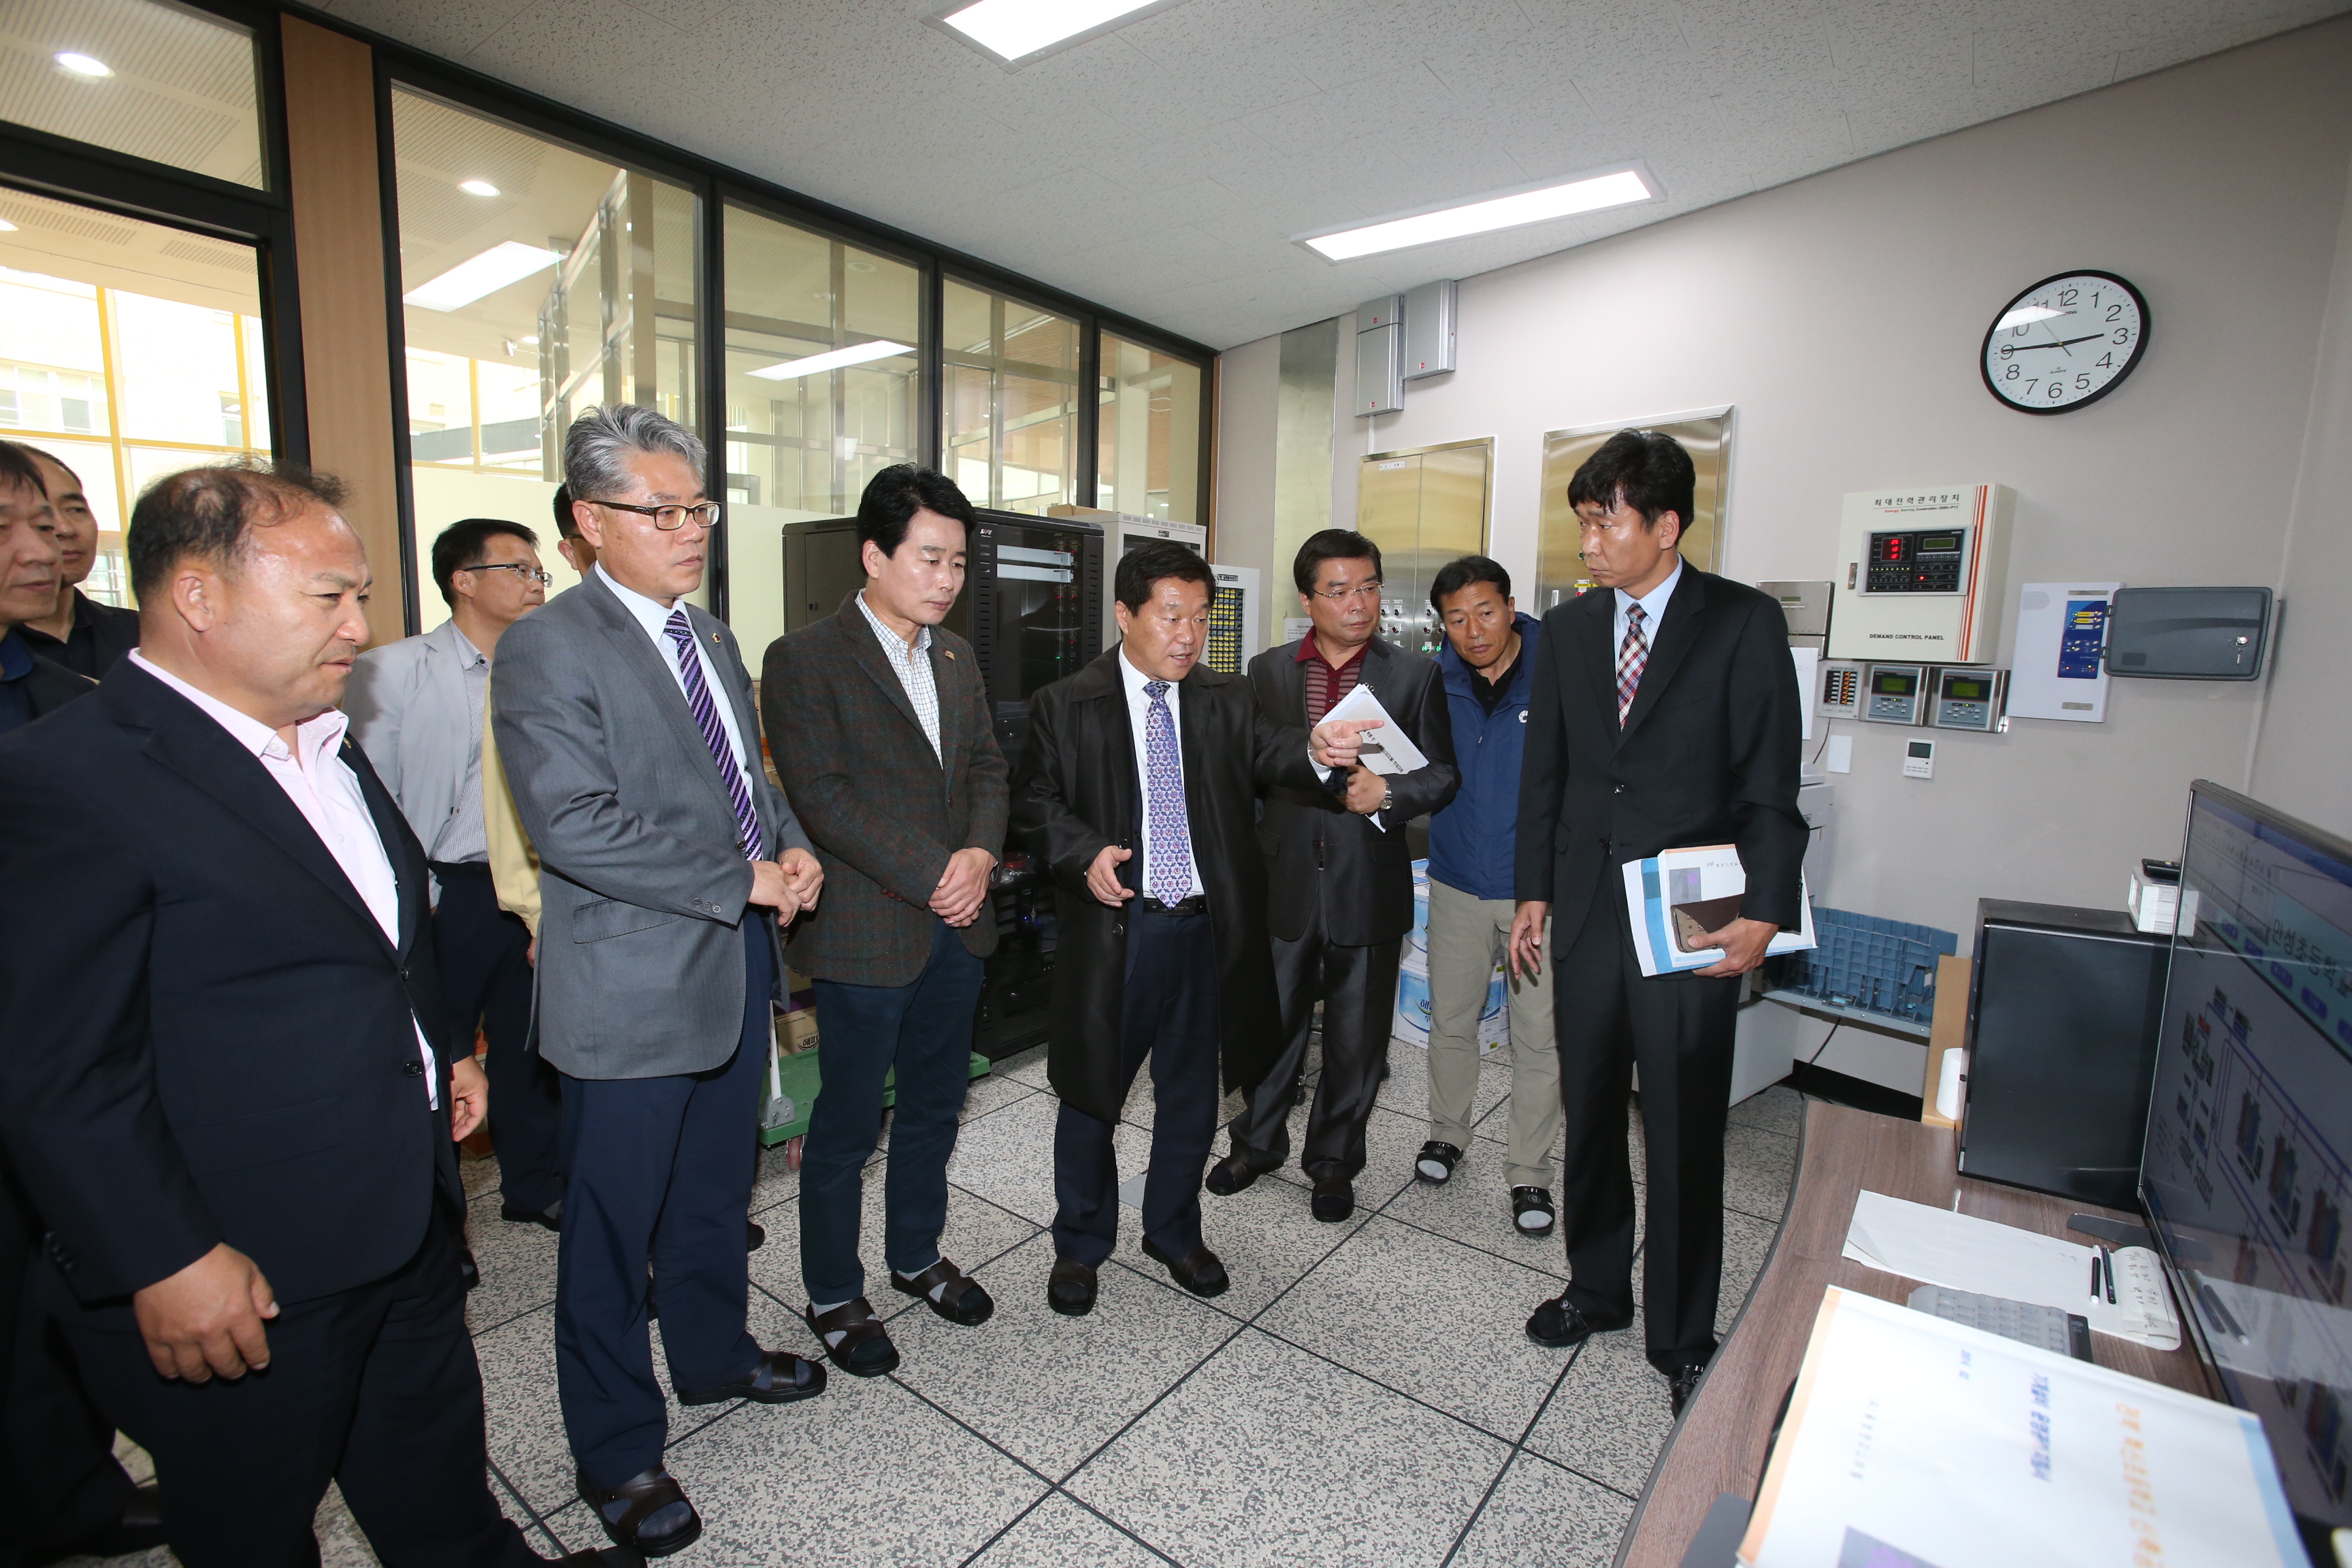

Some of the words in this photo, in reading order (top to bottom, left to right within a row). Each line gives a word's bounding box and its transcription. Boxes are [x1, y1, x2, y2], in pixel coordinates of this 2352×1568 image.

[2057, 289, 2078, 308] 12
[2091, 292, 2100, 308] 1
[2106, 304, 2122, 322] 2
[2011, 321, 2030, 337] 10
[2112, 328, 2128, 345] 3
[2001, 344, 2014, 360] 9
[2095, 352, 2113, 369] 4
[2006, 364, 2020, 380] 8
[2025, 378, 2039, 395] 7
[2076, 373, 2090, 390] 5
[2048, 382, 2063, 399] 6
